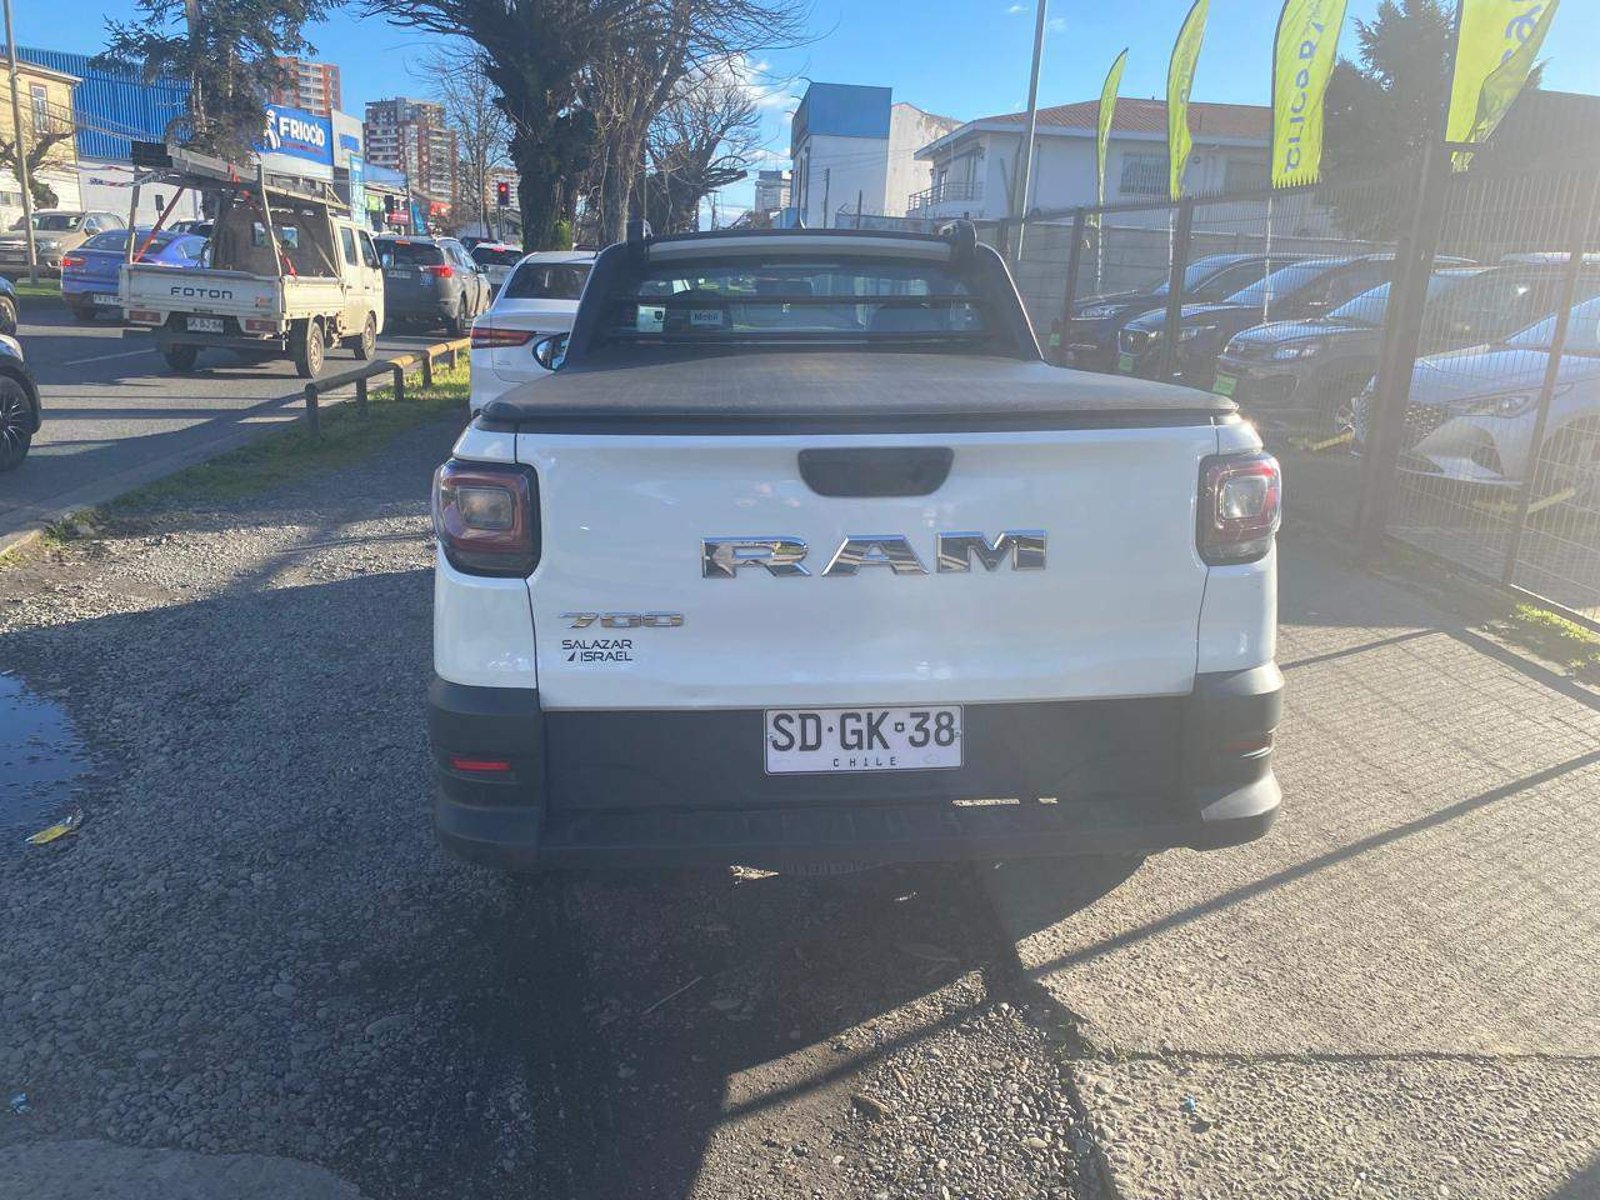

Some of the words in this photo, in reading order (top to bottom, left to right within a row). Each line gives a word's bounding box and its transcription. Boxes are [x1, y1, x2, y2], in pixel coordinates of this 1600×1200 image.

[170, 286, 232, 299] FOTON
[702, 530, 1047, 577] RAM
[558, 610, 685, 629] 700
[561, 639, 633, 650] SALAZAR
[580, 651, 634, 662] ISRAEL
[832, 755, 898, 768] CHILE
